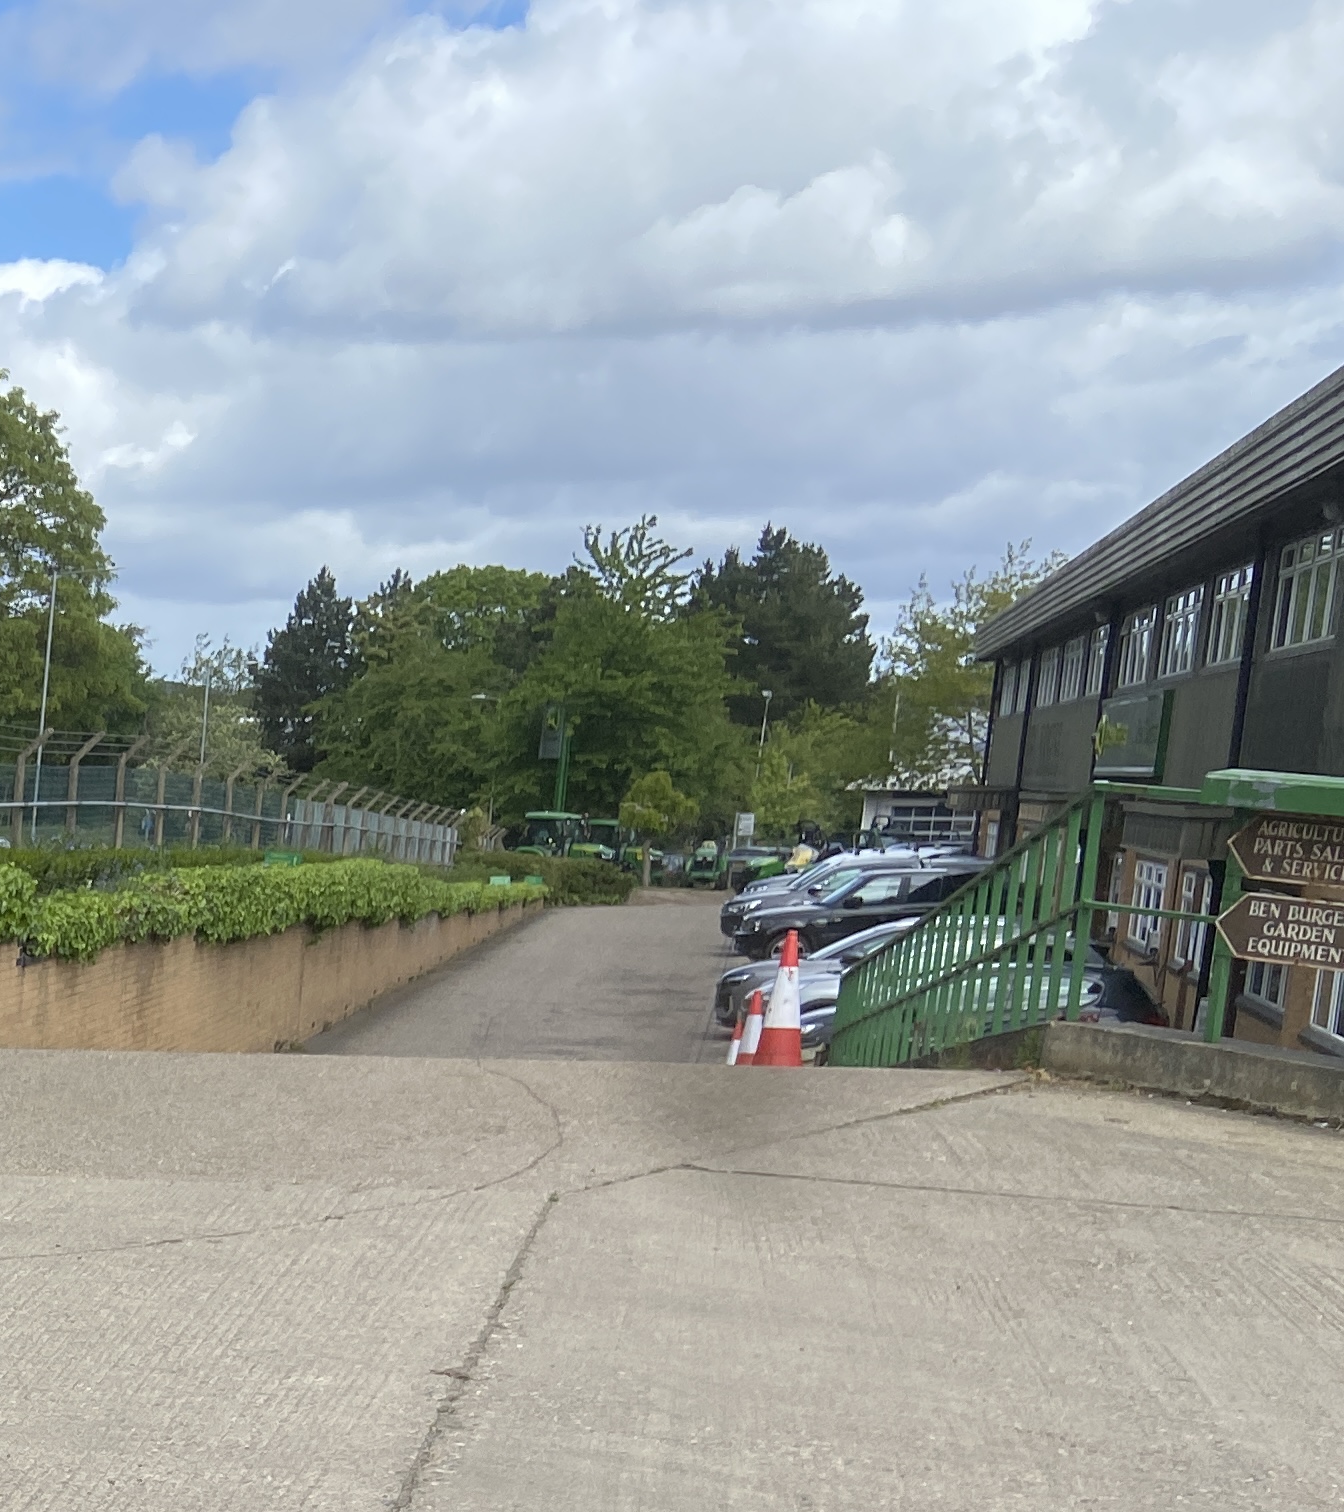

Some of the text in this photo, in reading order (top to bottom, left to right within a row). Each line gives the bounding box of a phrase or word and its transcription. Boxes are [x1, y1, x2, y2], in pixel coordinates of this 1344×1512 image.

[1262, 857, 1274, 873] &
[1249, 900, 1281, 919] BEN
[1263, 920, 1336, 944] GARDEN
[1247, 936, 1344, 964] EQUIPMEN
